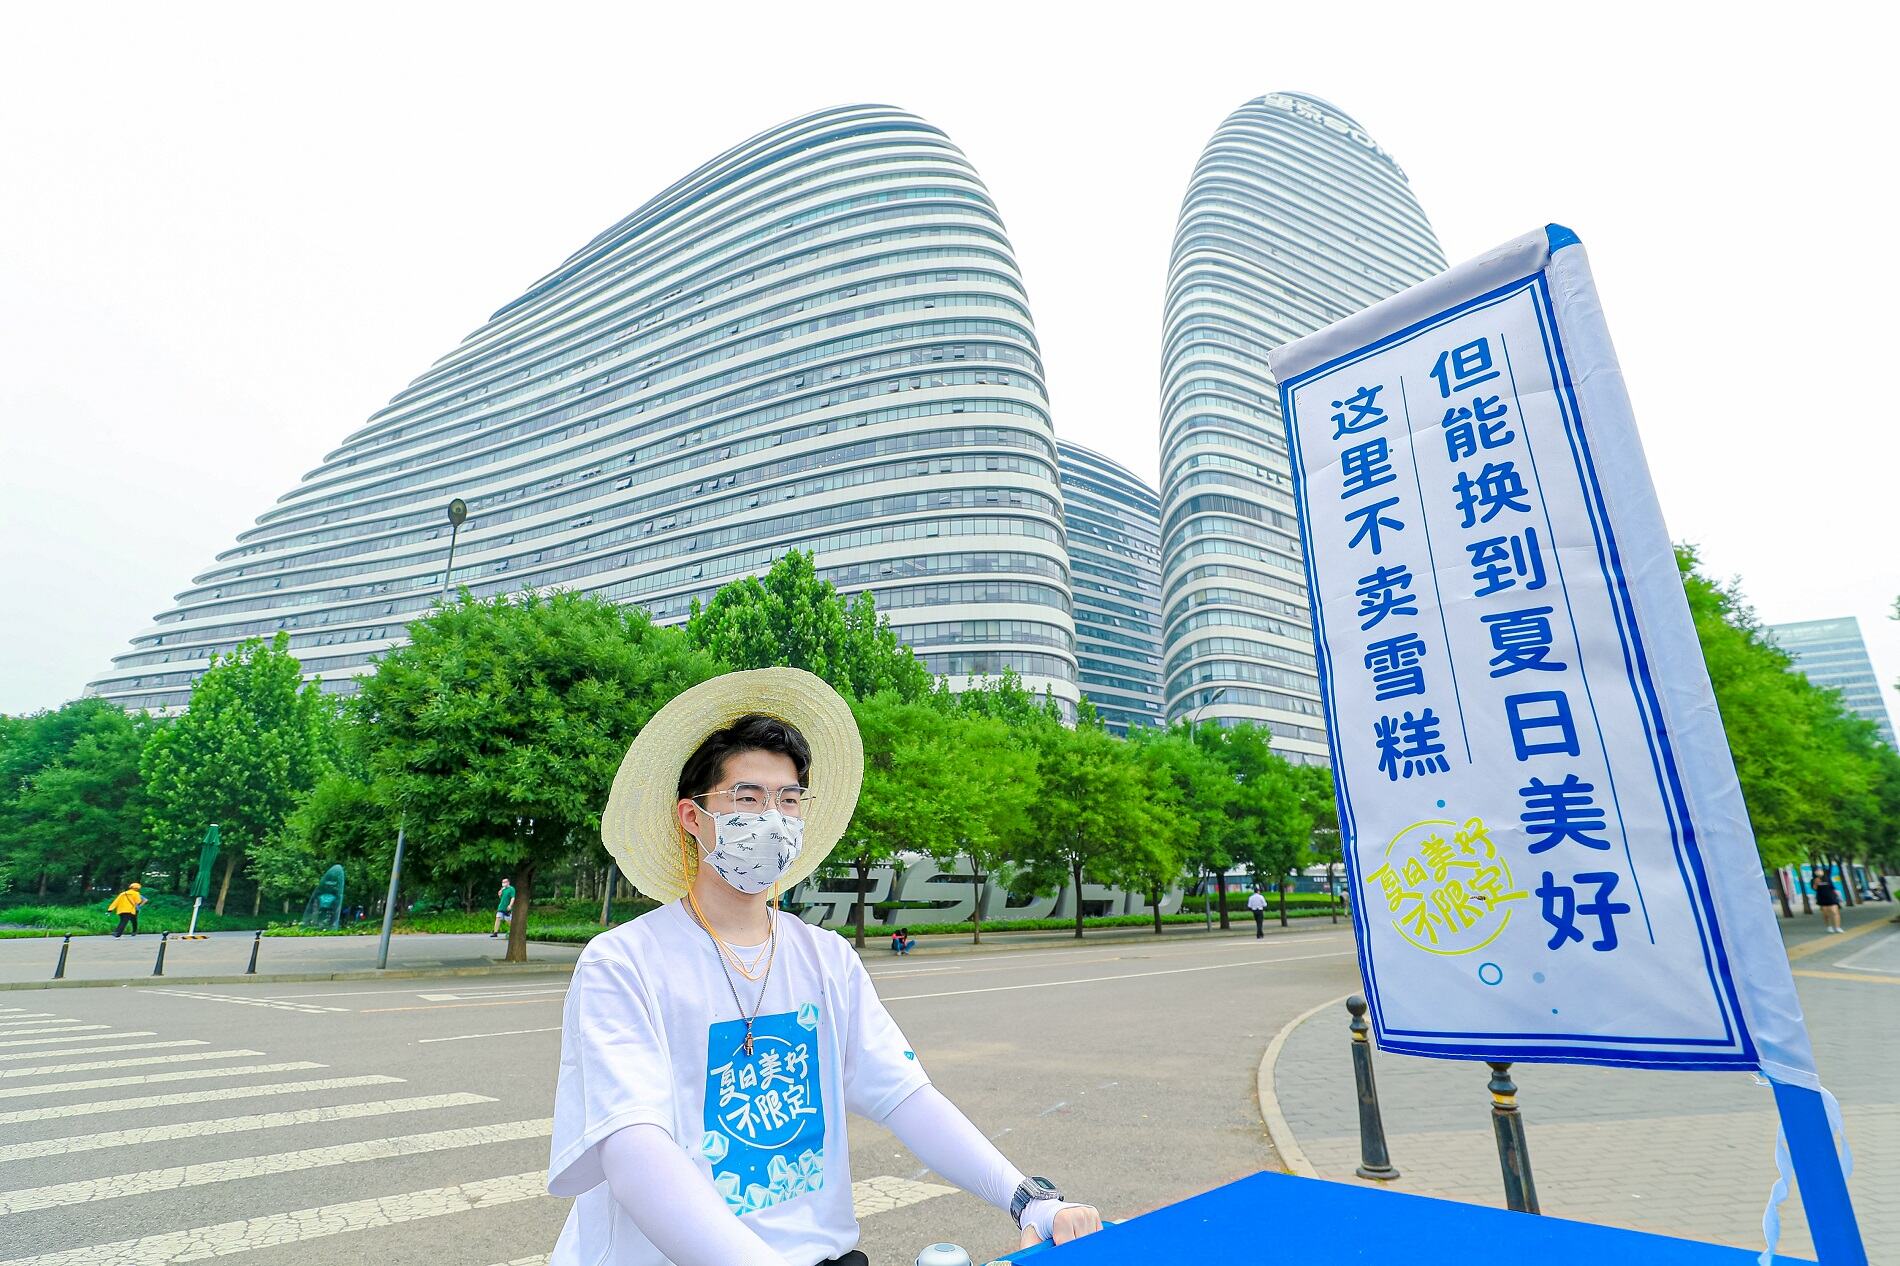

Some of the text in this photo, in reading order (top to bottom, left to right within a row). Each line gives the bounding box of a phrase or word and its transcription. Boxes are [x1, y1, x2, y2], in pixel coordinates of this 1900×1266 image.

[1331, 383, 1451, 782] 这里不卖雪糕
[1430, 336, 1631, 952] 但能换到夏日美好
[1366, 816, 1496, 912] 夏日美好
[1401, 865, 1529, 944] 不限定
[710, 1043, 809, 1107] 夏日美好
[727, 1084, 817, 1138] 不限定
